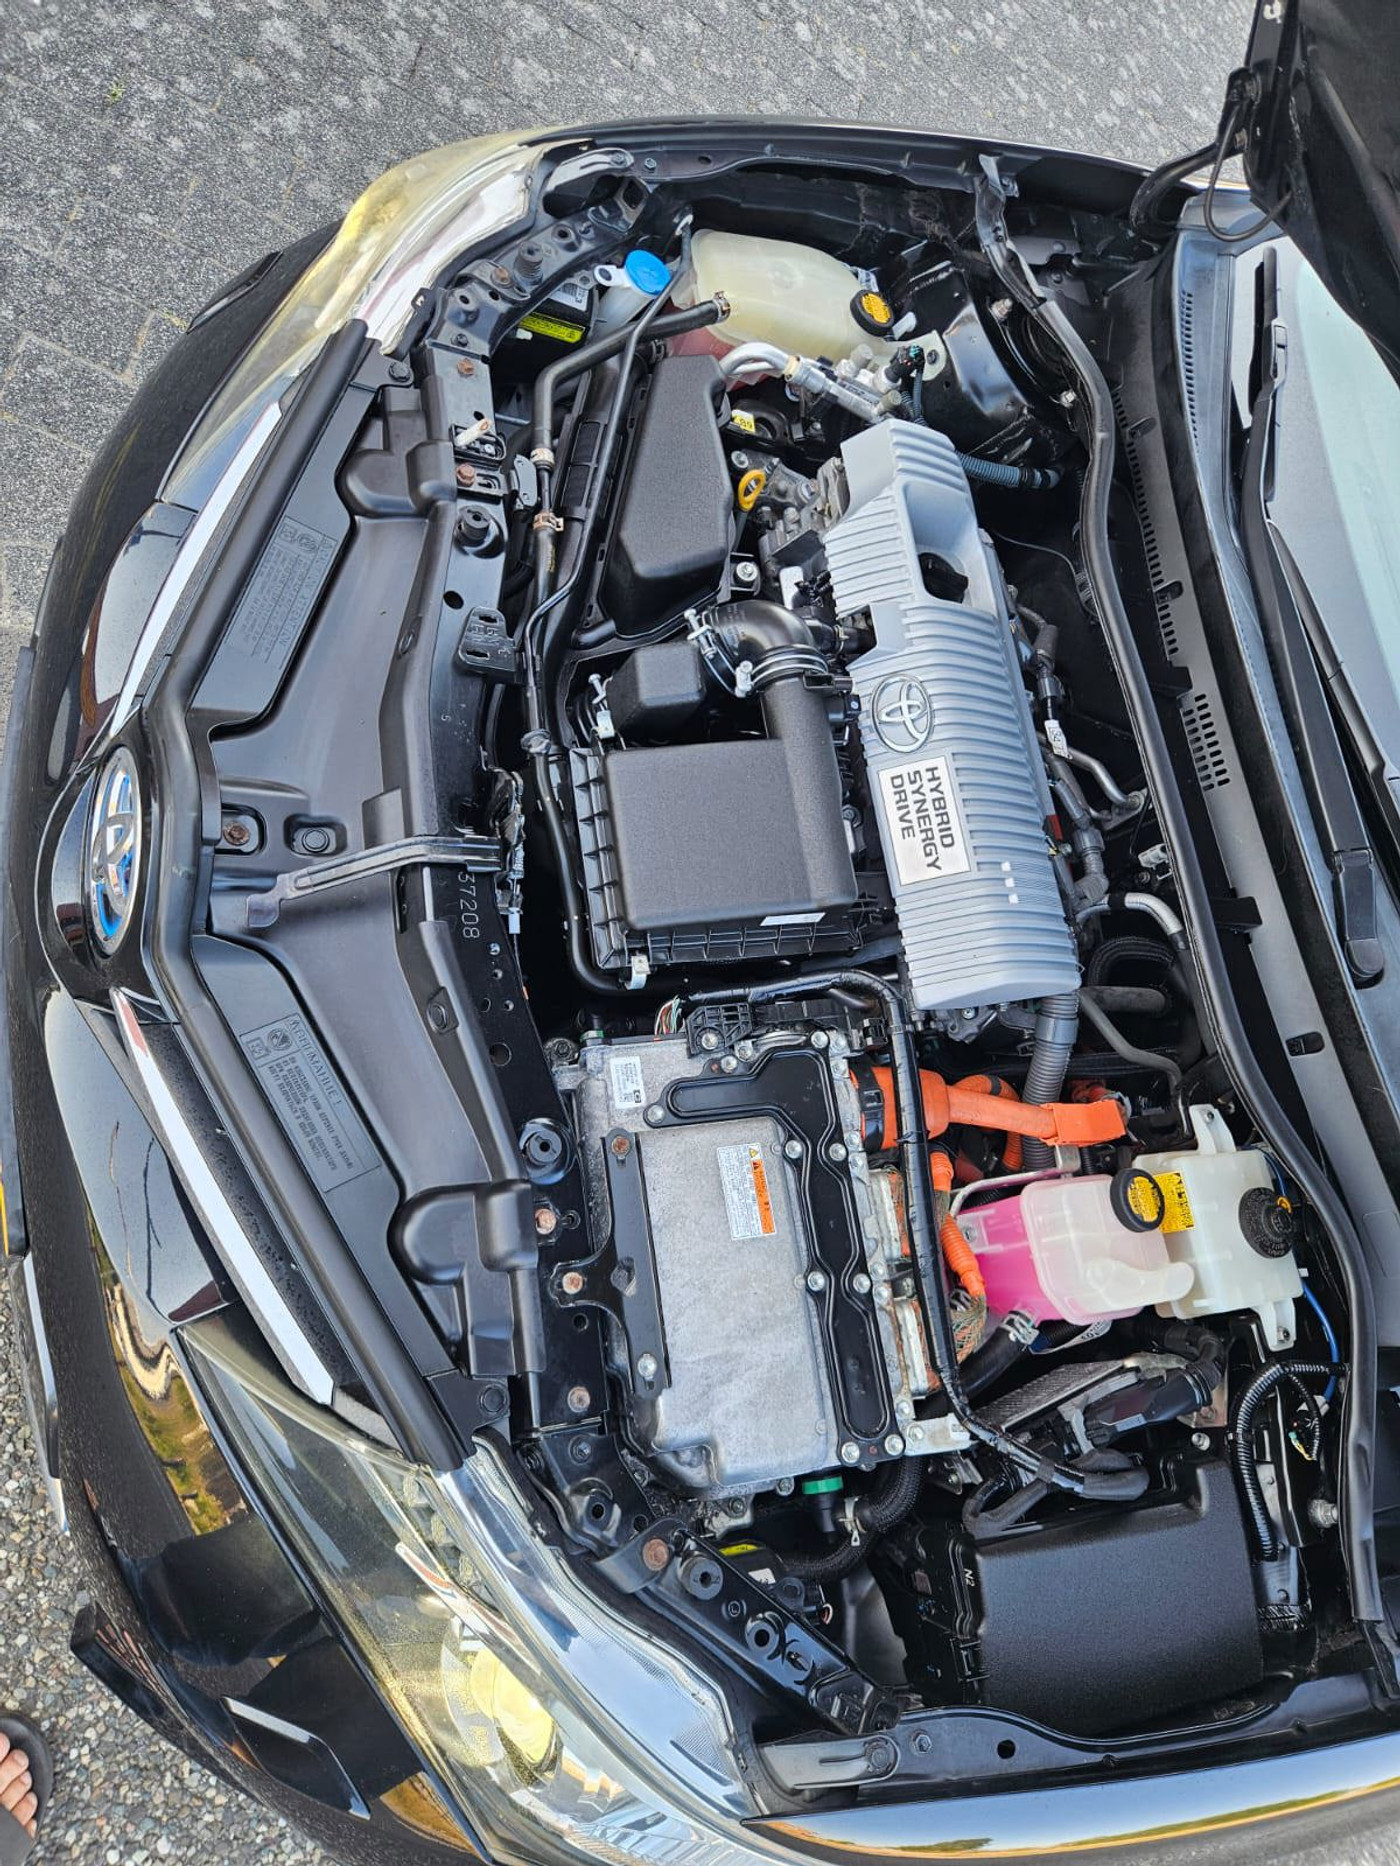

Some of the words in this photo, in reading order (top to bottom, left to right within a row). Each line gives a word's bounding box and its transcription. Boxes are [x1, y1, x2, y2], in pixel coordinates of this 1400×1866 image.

[890, 774, 916, 840] DRIVE
[908, 770, 942, 870] SYNERGY
[926, 766, 955, 848] HYBRID
[458, 871, 480, 939] 37208
